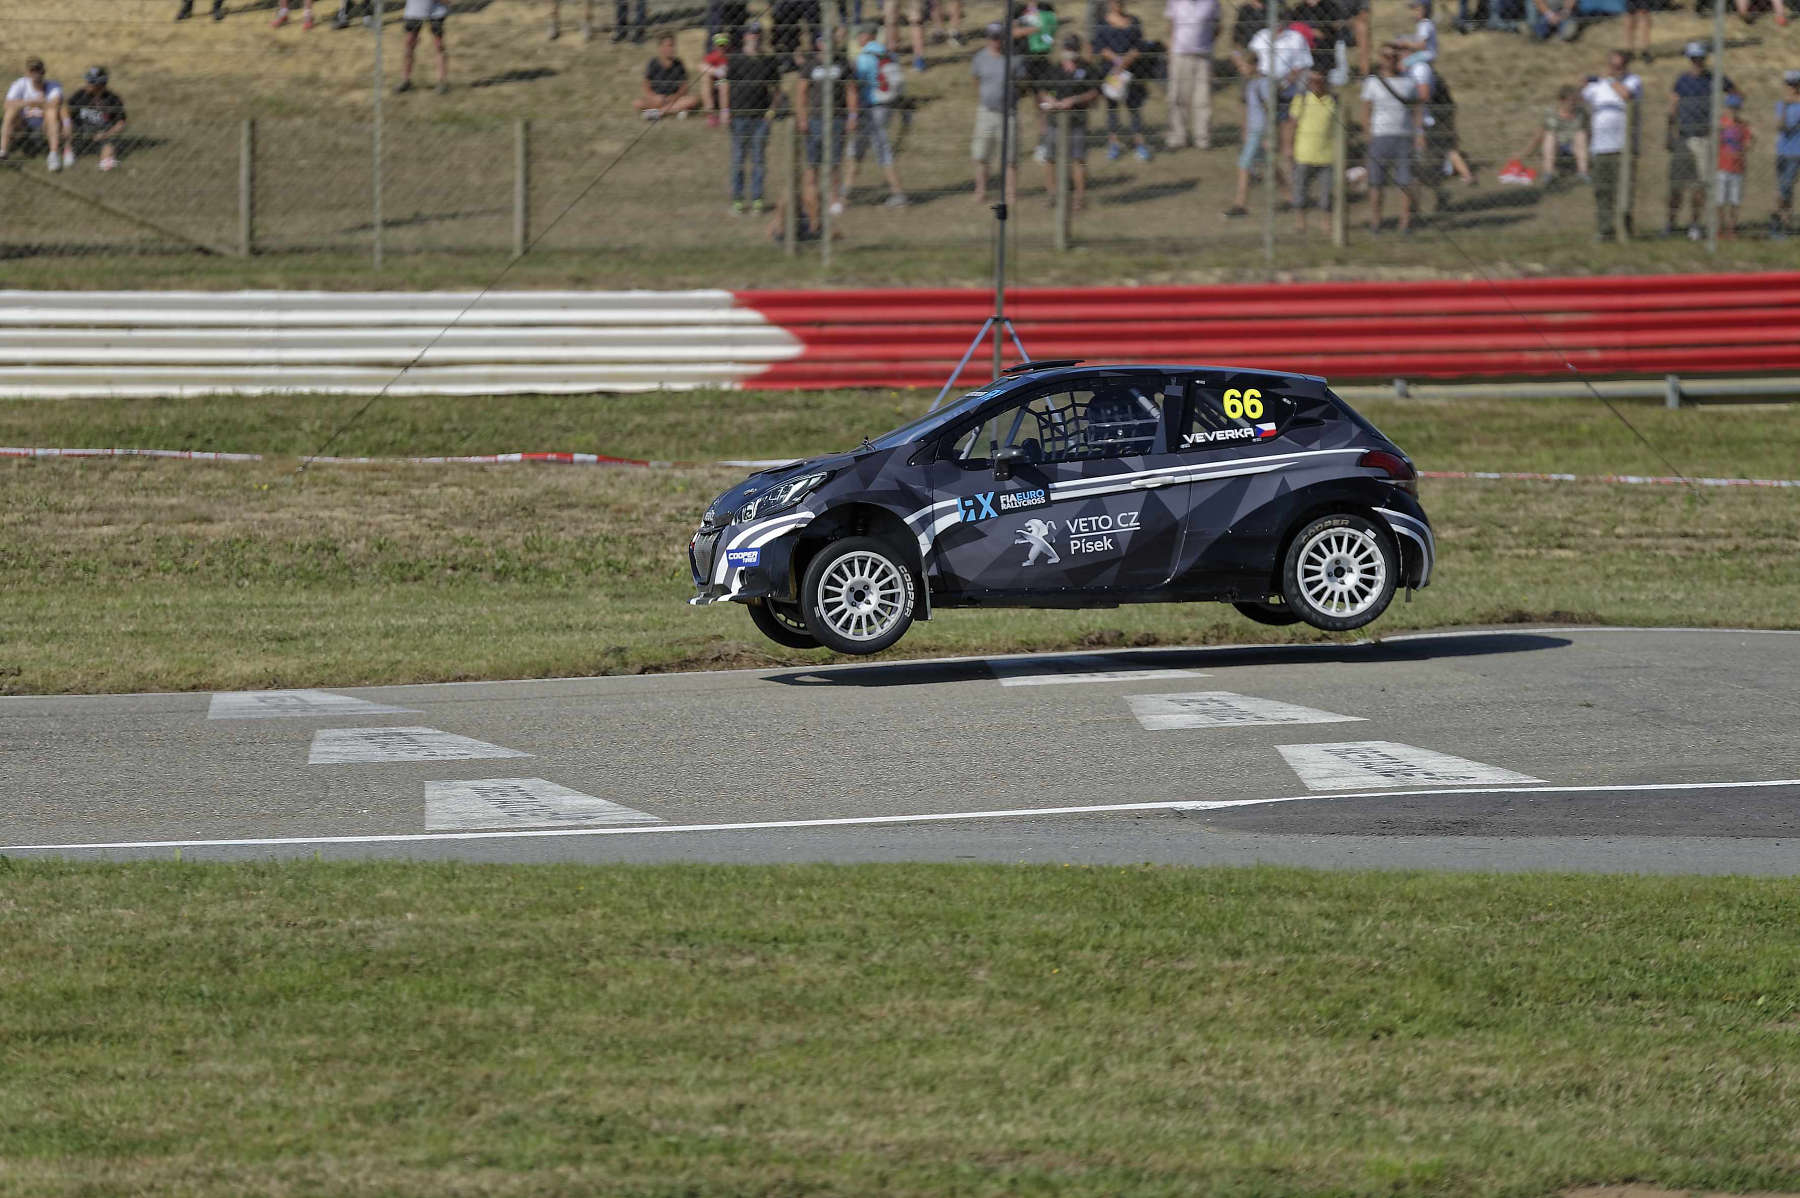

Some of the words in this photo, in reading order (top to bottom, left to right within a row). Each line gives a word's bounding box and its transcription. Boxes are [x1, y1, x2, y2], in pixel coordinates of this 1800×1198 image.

[1223, 388, 1264, 419] 66
[1182, 427, 1255, 444] VEVERKA
[1001, 496, 1046, 511] RALLYCROSS
[1065, 515, 1113, 533] VETO
[1117, 511, 1141, 527] CZ
[1070, 535, 1114, 555] Písek
[728, 551, 758, 560] COOPER
[898, 564, 915, 618] COOPER
